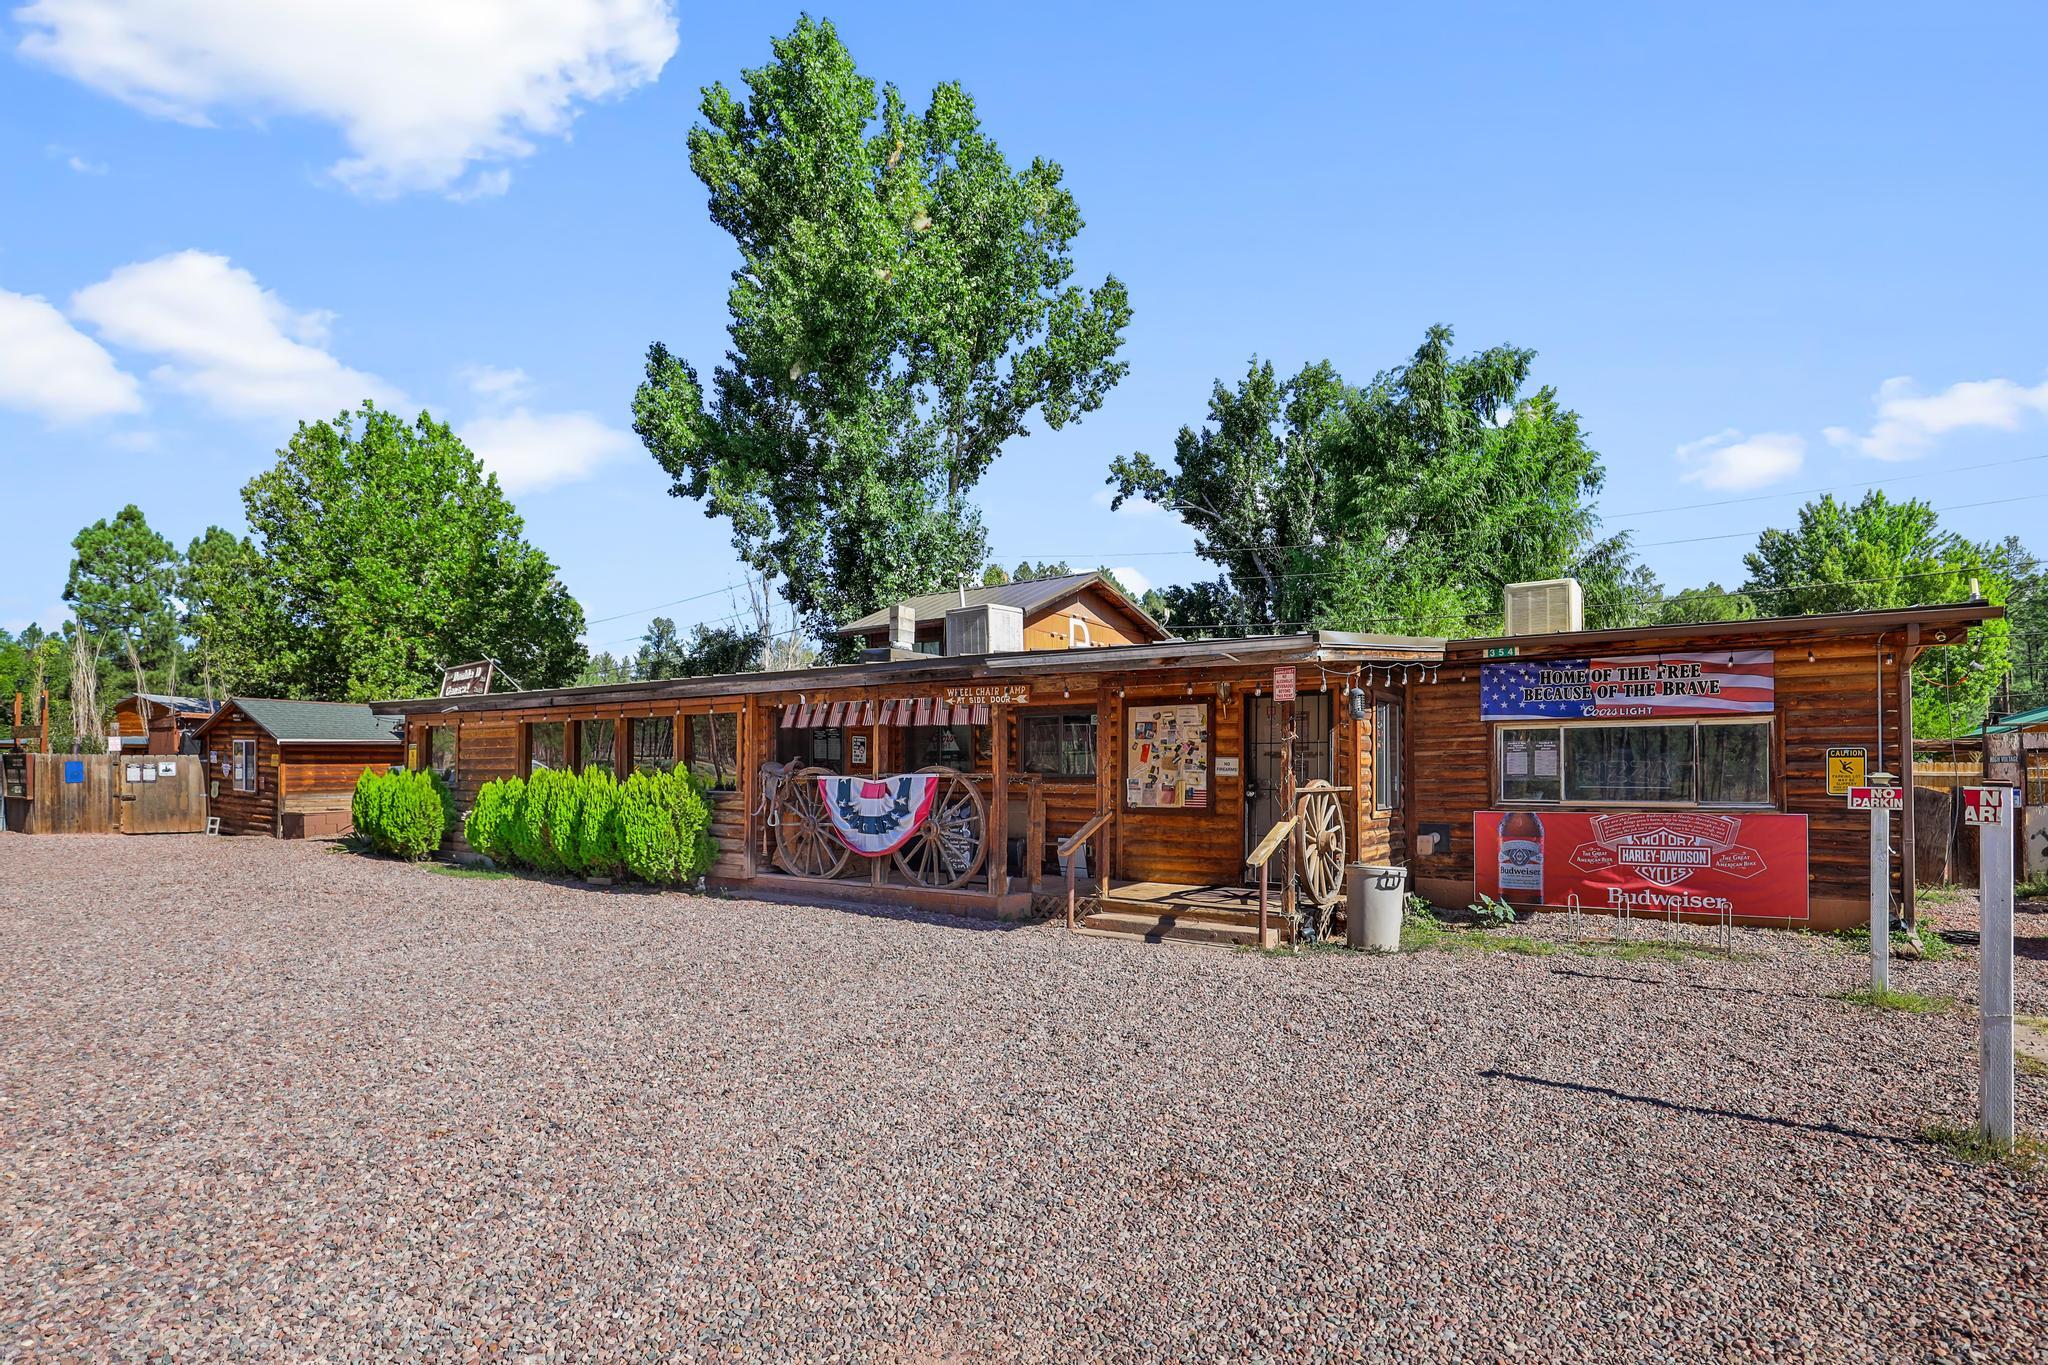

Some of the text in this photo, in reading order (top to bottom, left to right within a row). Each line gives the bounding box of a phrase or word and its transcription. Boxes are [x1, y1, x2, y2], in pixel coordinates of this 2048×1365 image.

[1069, 617, 1090, 648] D
[1490, 648, 1513, 656] 354
[1540, 664, 1702, 685] HOME OF THE FREE
[976, 687, 999, 696] CHAIR
[1524, 680, 1721, 702] BECAUSE OF THE BRAVE
[991, 696, 1011, 704] DOOR
[1583, 705, 1653, 717] Coors LIGHT
[1830, 749, 1863, 757] CAUTION
[1871, 789, 1895, 798] NO
[1641, 831, 1686, 846] MOTOR
[1622, 849, 1706, 864] HARLEY-DAVIDSON
[1500, 866, 1541, 876] Budweiser
[1641, 866, 1686, 883] CYCLES
[1607, 887, 1727, 909] Budweiser
